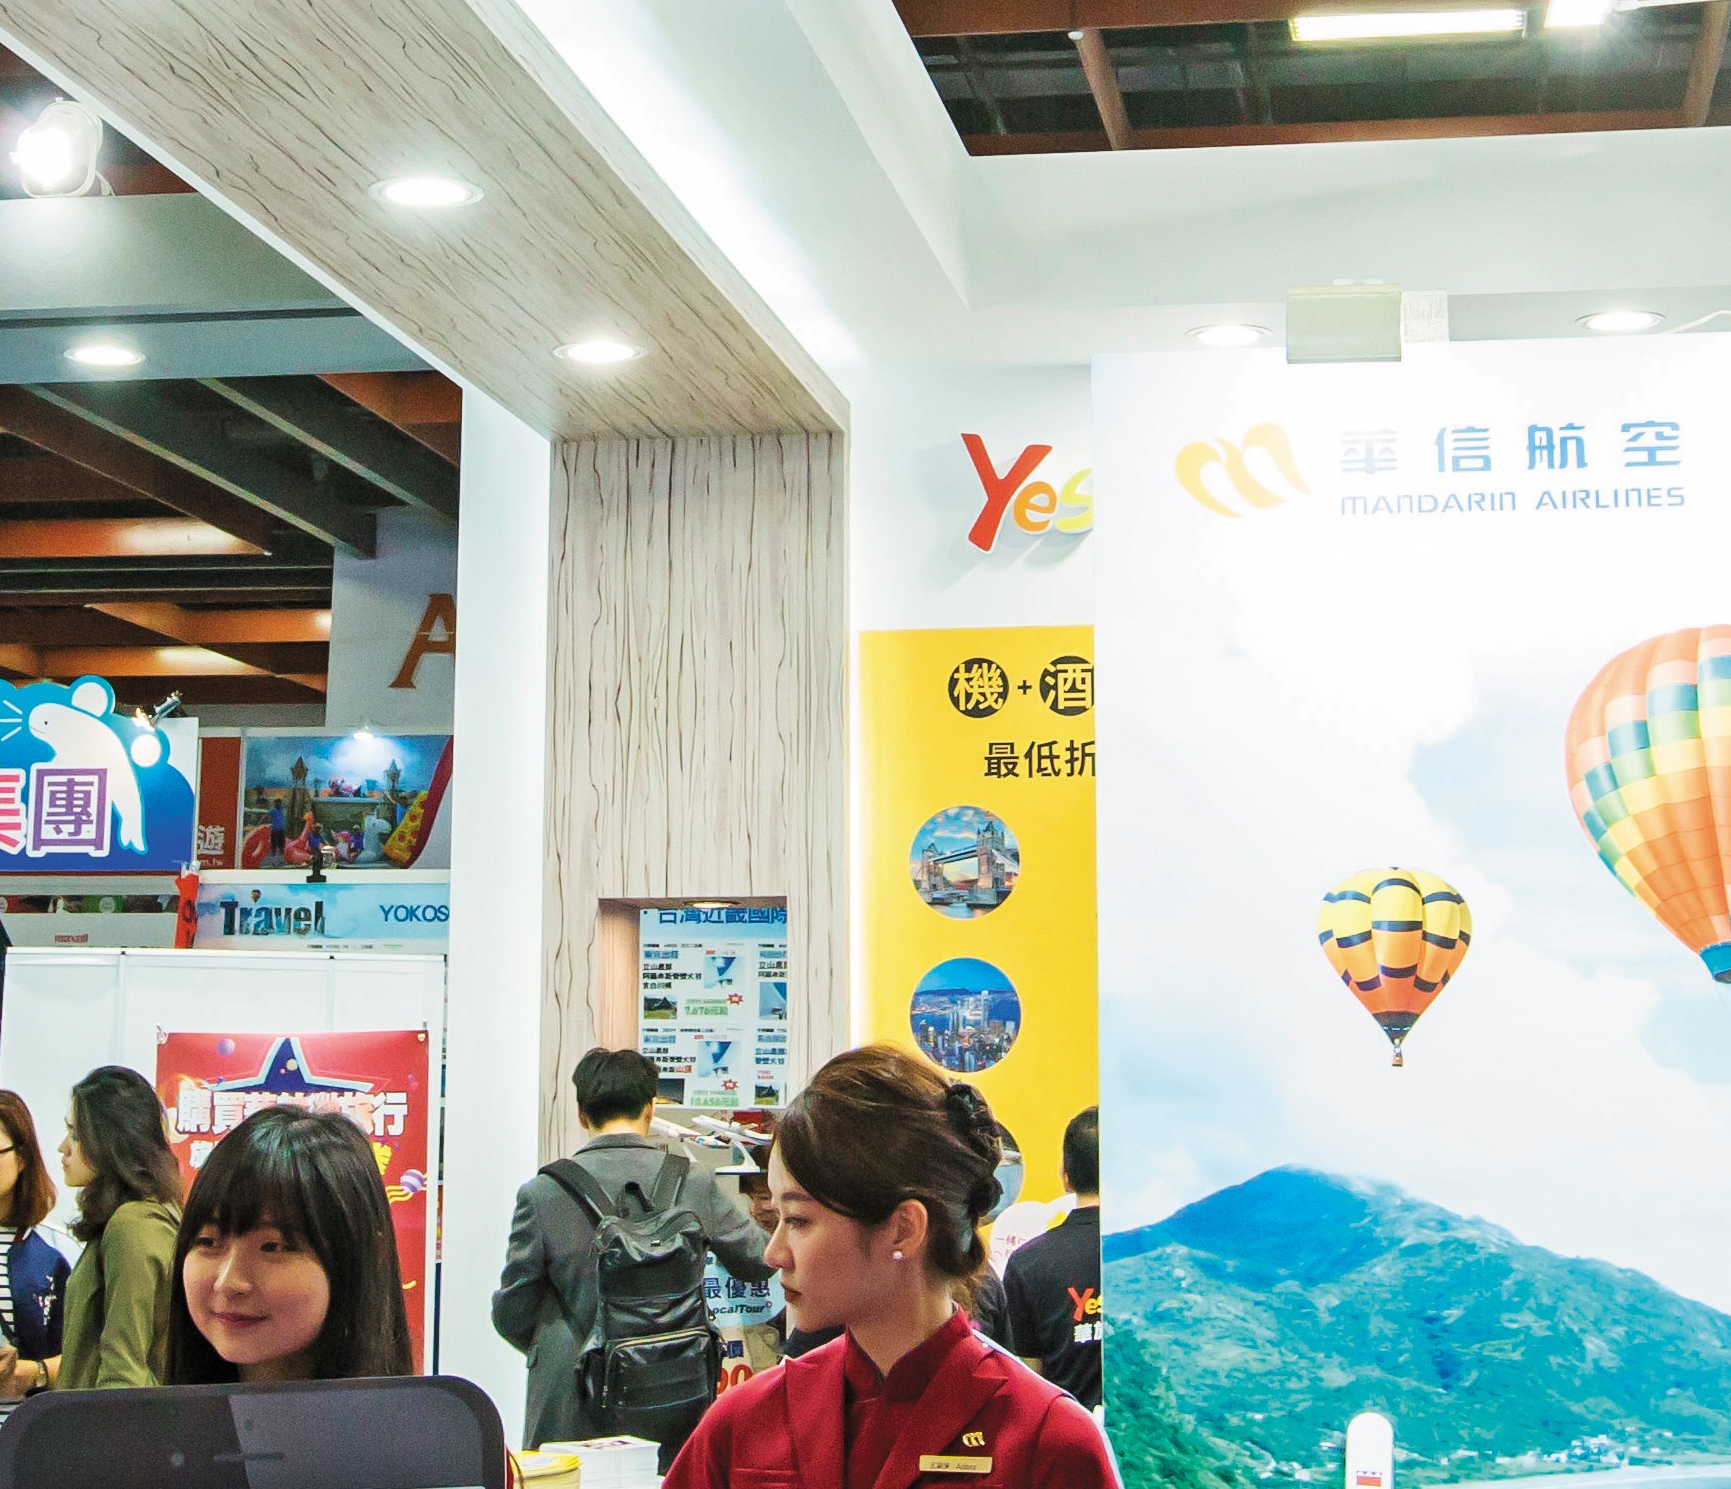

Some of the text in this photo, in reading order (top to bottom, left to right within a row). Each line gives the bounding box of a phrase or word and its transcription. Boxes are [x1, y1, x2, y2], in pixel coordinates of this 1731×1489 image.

[1339, 420, 1681, 474] 華信航空
[1341, 487, 1685, 515] MANDARIN AIRLINES
[984, 740, 1096, 779] 最低折
[220, 900, 325, 935] Travel
